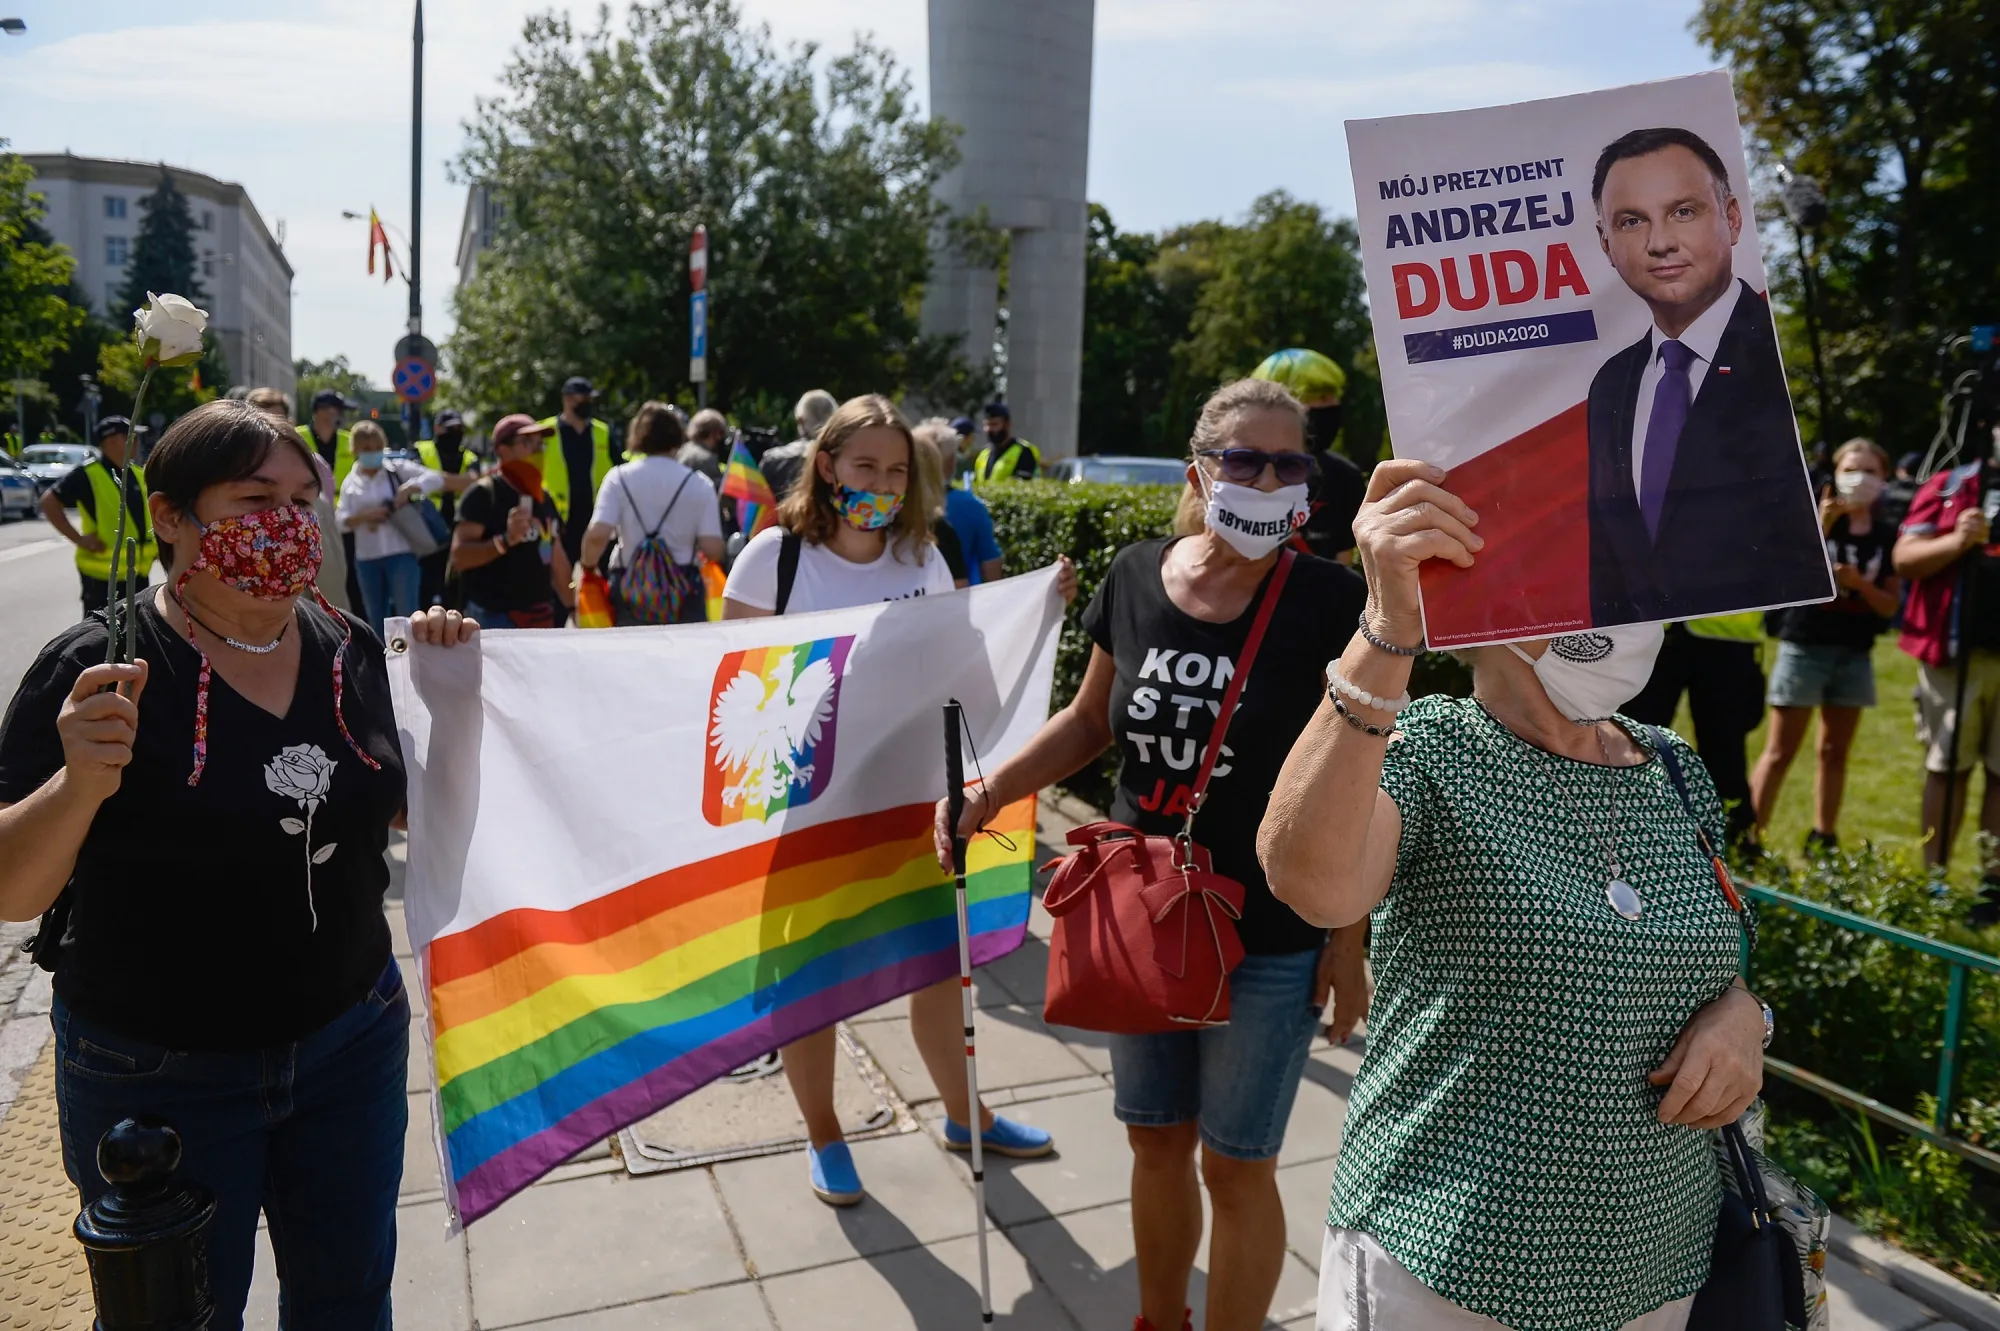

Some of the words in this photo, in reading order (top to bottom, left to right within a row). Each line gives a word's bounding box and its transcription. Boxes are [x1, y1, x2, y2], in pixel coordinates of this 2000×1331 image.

[1378, 174, 1429, 200] MÓJ
[1433, 158, 1565, 193] PREZYDENT
[1386, 191, 1575, 249] ANDRZEJ
[1392, 242, 1591, 320] DUDA
[1452, 323, 1549, 350] #DUDA2020
[1218, 508, 1286, 537] OBYWATELE
[1138, 648, 1248, 692] KON
[1126, 732, 1234, 777] TUC
[1138, 778, 1193, 819] JA
